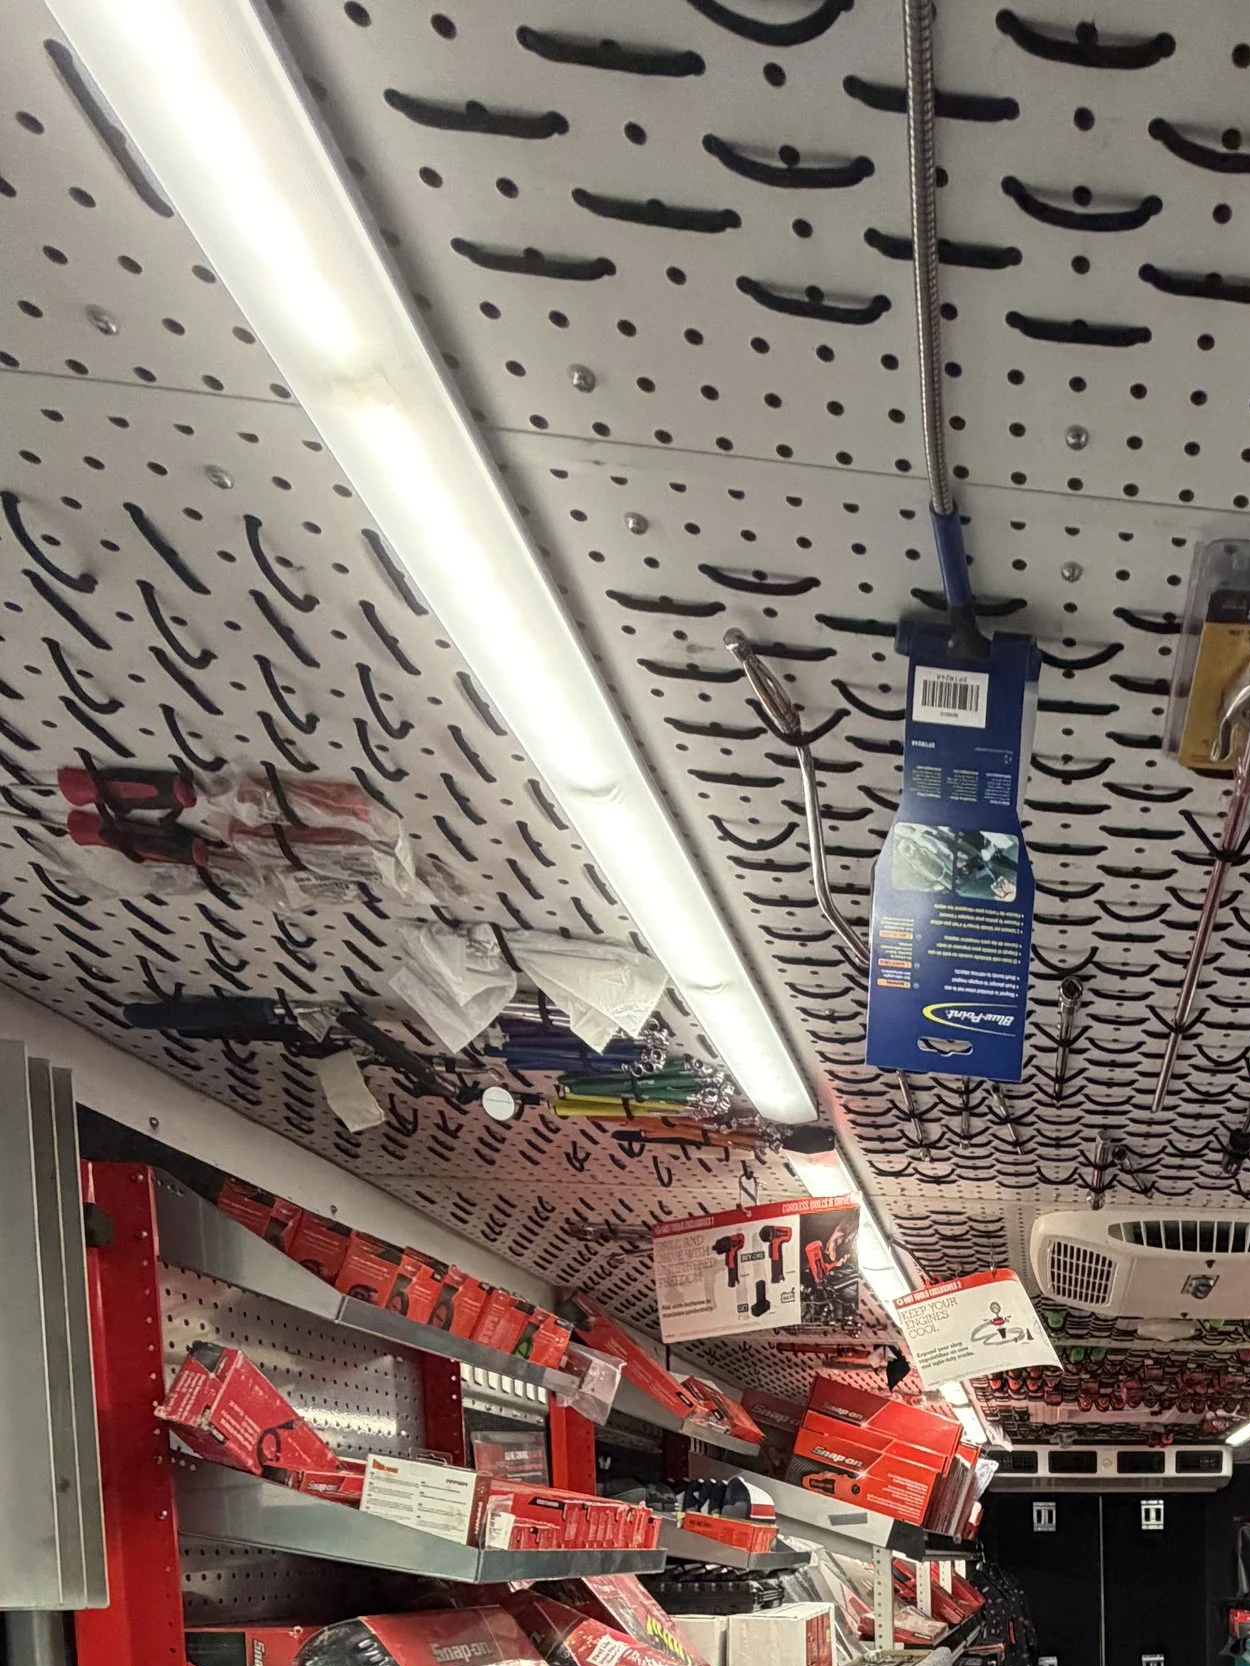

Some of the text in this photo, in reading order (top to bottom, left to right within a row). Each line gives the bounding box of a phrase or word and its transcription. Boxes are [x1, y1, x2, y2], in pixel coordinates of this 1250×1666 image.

[684, 1234, 705, 1246] AND
[901, 1297, 958, 1321] KEEP YOUR
[904, 1310, 949, 1331] ENGINES
[937, 1343, 950, 1354] your
[950, 1340, 963, 1350] shop
[921, 1361, 932, 1369] and
[811, 1445, 864, 1469] Snap-on
[430, 1640, 495, 1663] Snap-on
